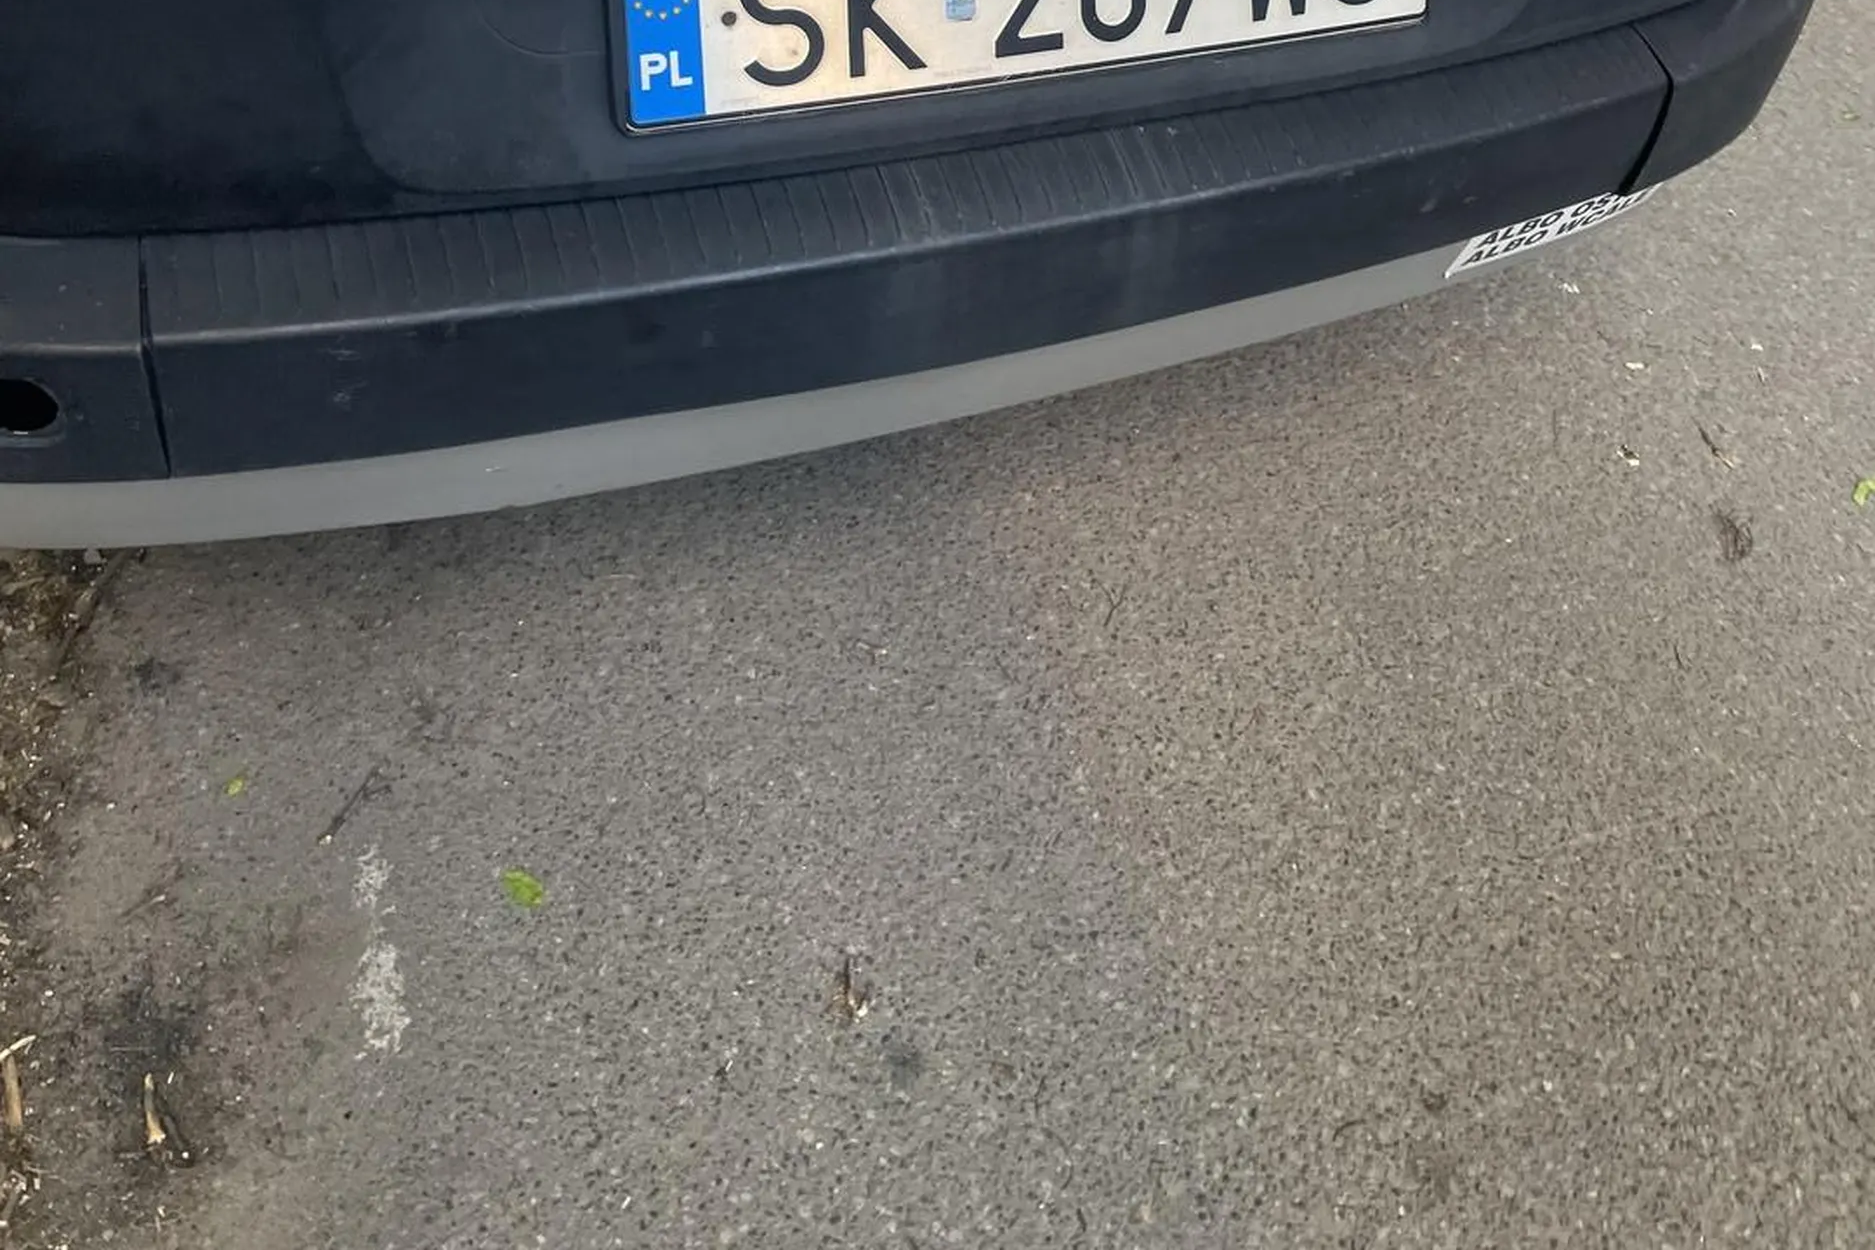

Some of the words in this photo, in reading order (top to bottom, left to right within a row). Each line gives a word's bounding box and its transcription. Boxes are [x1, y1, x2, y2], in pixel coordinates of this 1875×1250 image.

[639, 51, 693, 92] PL
[1477, 211, 1564, 248] ALBO
[1460, 230, 1548, 267] ALBO
